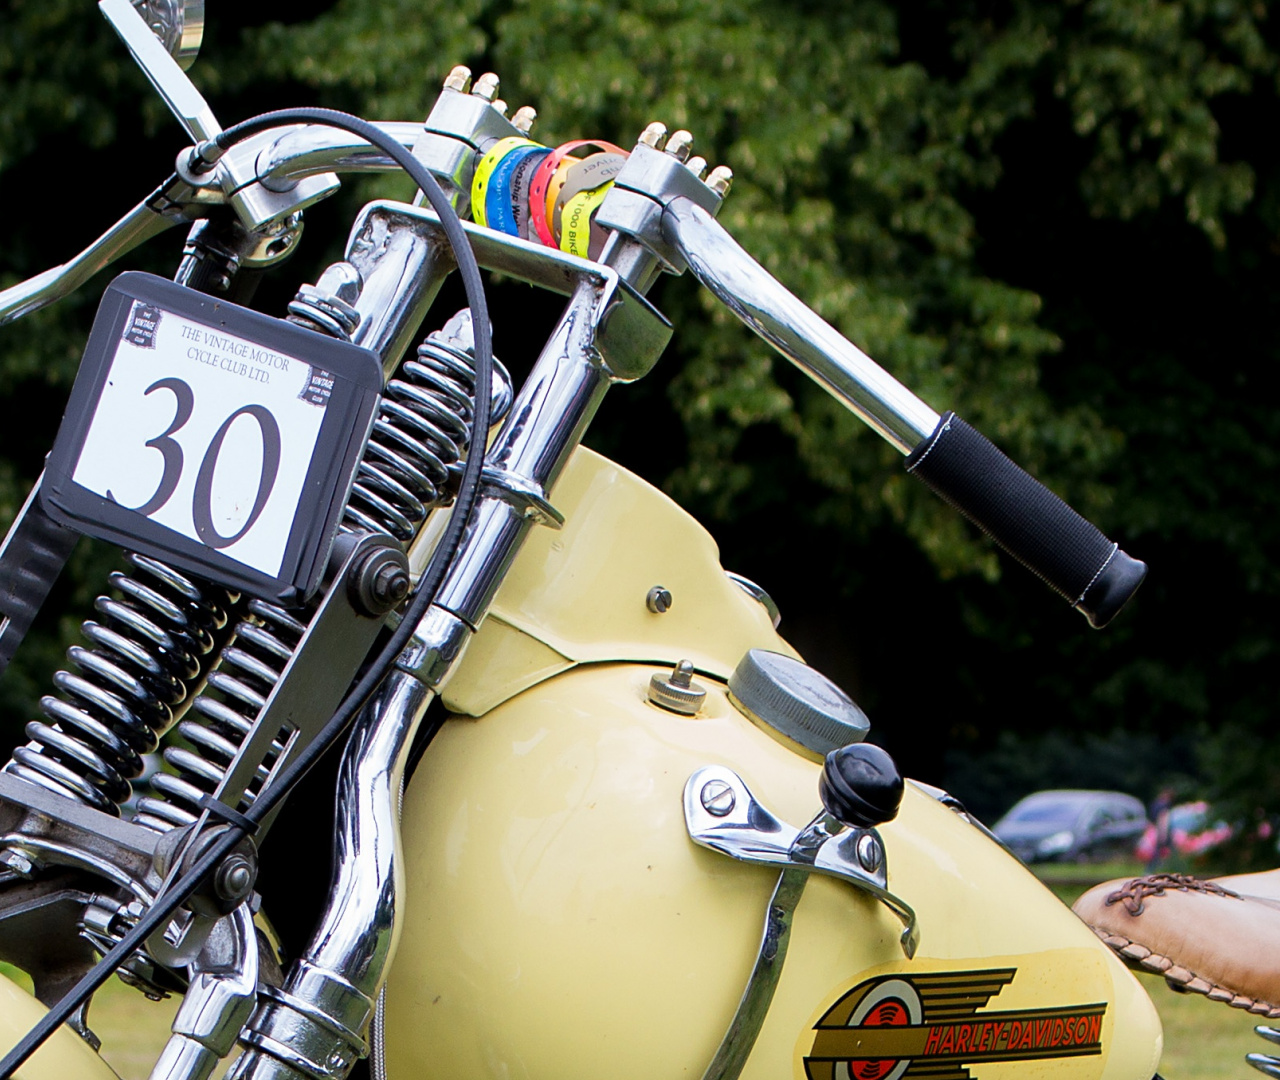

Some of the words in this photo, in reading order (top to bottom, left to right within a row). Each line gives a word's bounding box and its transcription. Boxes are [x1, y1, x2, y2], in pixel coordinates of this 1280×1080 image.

[569, 202, 585, 229] 1000
[134, 317, 157, 331] VINTAGE
[181, 325, 203, 342] THE
[204, 332, 249, 358] VINTAGE
[249, 348, 290, 372] MOTOR
[187, 346, 220, 367] CYCLE
[220, 357, 248, 377] CLUB
[248, 366, 270, 384] LTD.
[311, 376, 335, 390] VINTAGE
[106, 377, 281, 549] 30
[924, 1014, 1102, 1055] HARLEY-DAVIDSON
